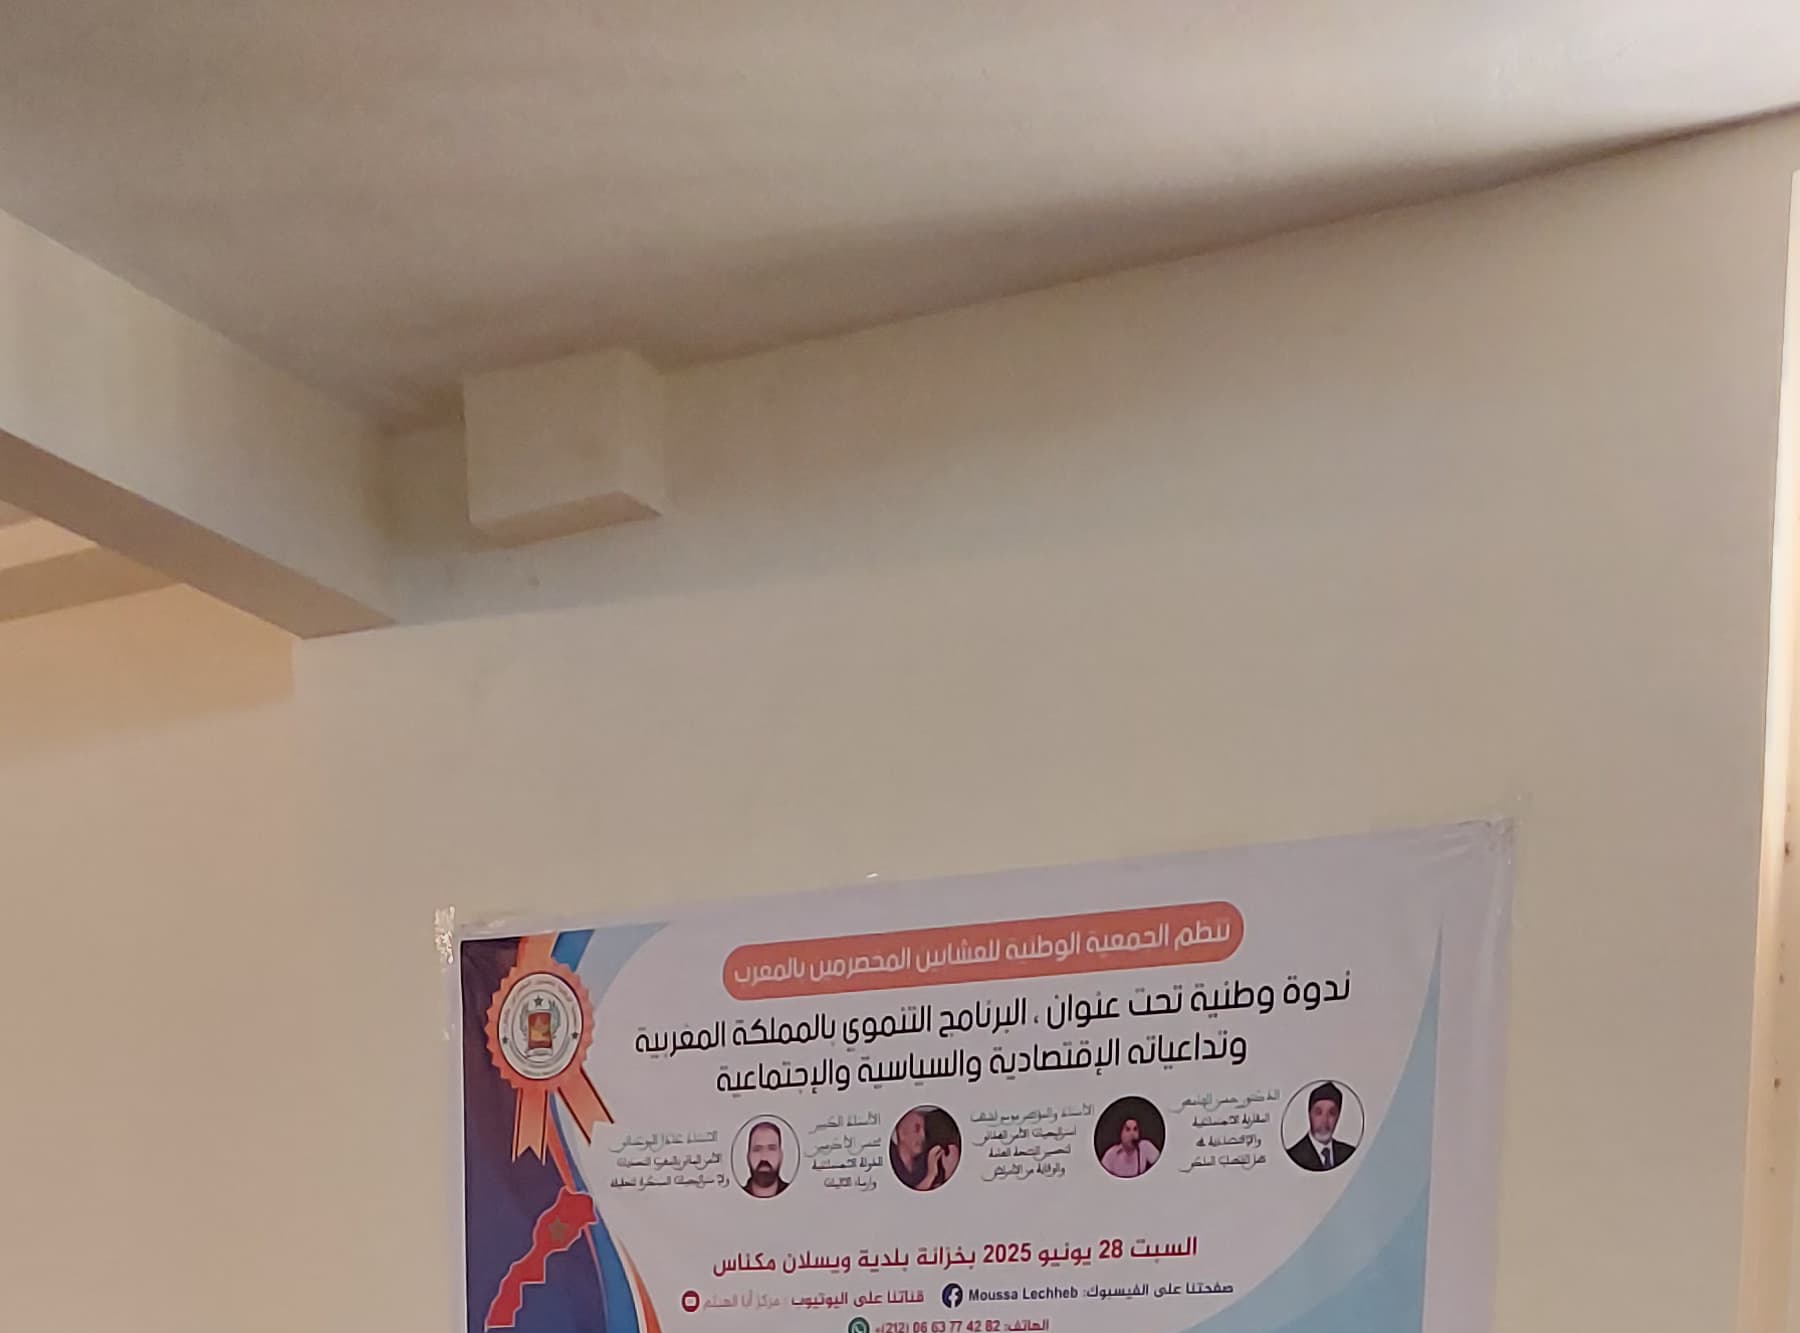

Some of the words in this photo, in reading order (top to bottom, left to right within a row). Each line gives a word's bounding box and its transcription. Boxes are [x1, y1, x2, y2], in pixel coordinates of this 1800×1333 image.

[1005, 930, 1081, 965] الوطنية
[1086, 922, 1170, 958] الجمعية
[1175, 917, 1231, 951] تنظم
[915, 937, 1000, 974] للعشابين
[733, 956, 806, 988] بالمغرب
[1128, 984, 1184, 1016] تحت
[1189, 979, 1275, 1019] وطنية
[1283, 970, 1351, 1010] ندوة
[732, 1013, 835, 1048] بالمملكة
[843, 1004, 932, 1052] التنموي
[938, 997, 1027, 1038] البرنامج
[635, 1020, 727, 1059] المغربية
[1127, 1030, 1248, 1070] وتداعياته
[857, 1048, 983, 1090] والسياسية
[989, 1037, 1121, 1081] الإقتصادية
[716, 1057, 851, 1098] والإجتماعية
[713, 1253, 777, 1278] مكناس
[782, 1250, 851, 1275] ويسلان
[858, 1248, 909, 1273] بلدية
[916, 1245, 976, 1271] بخزانة
[982, 1243, 1032, 1264] 2025
[1038, 1242, 1092, 1268] يونيو
[1098, 1239, 1124, 1260] 28
[1130, 1236, 1198, 1263] السبت
[854, 1290, 883, 1308] على
[887, 1289, 925, 1305] قناتنا
[968, 1287, 1019, 1302] Moussa
[1022, 1286, 1079, 1300] Lechheb
[1153, 1281, 1182, 1298] على
[1186, 1281, 1234, 1295] صفحتنا
[949, 1320, 963, 1333] 77
[966, 1320, 982, 1332] 42
